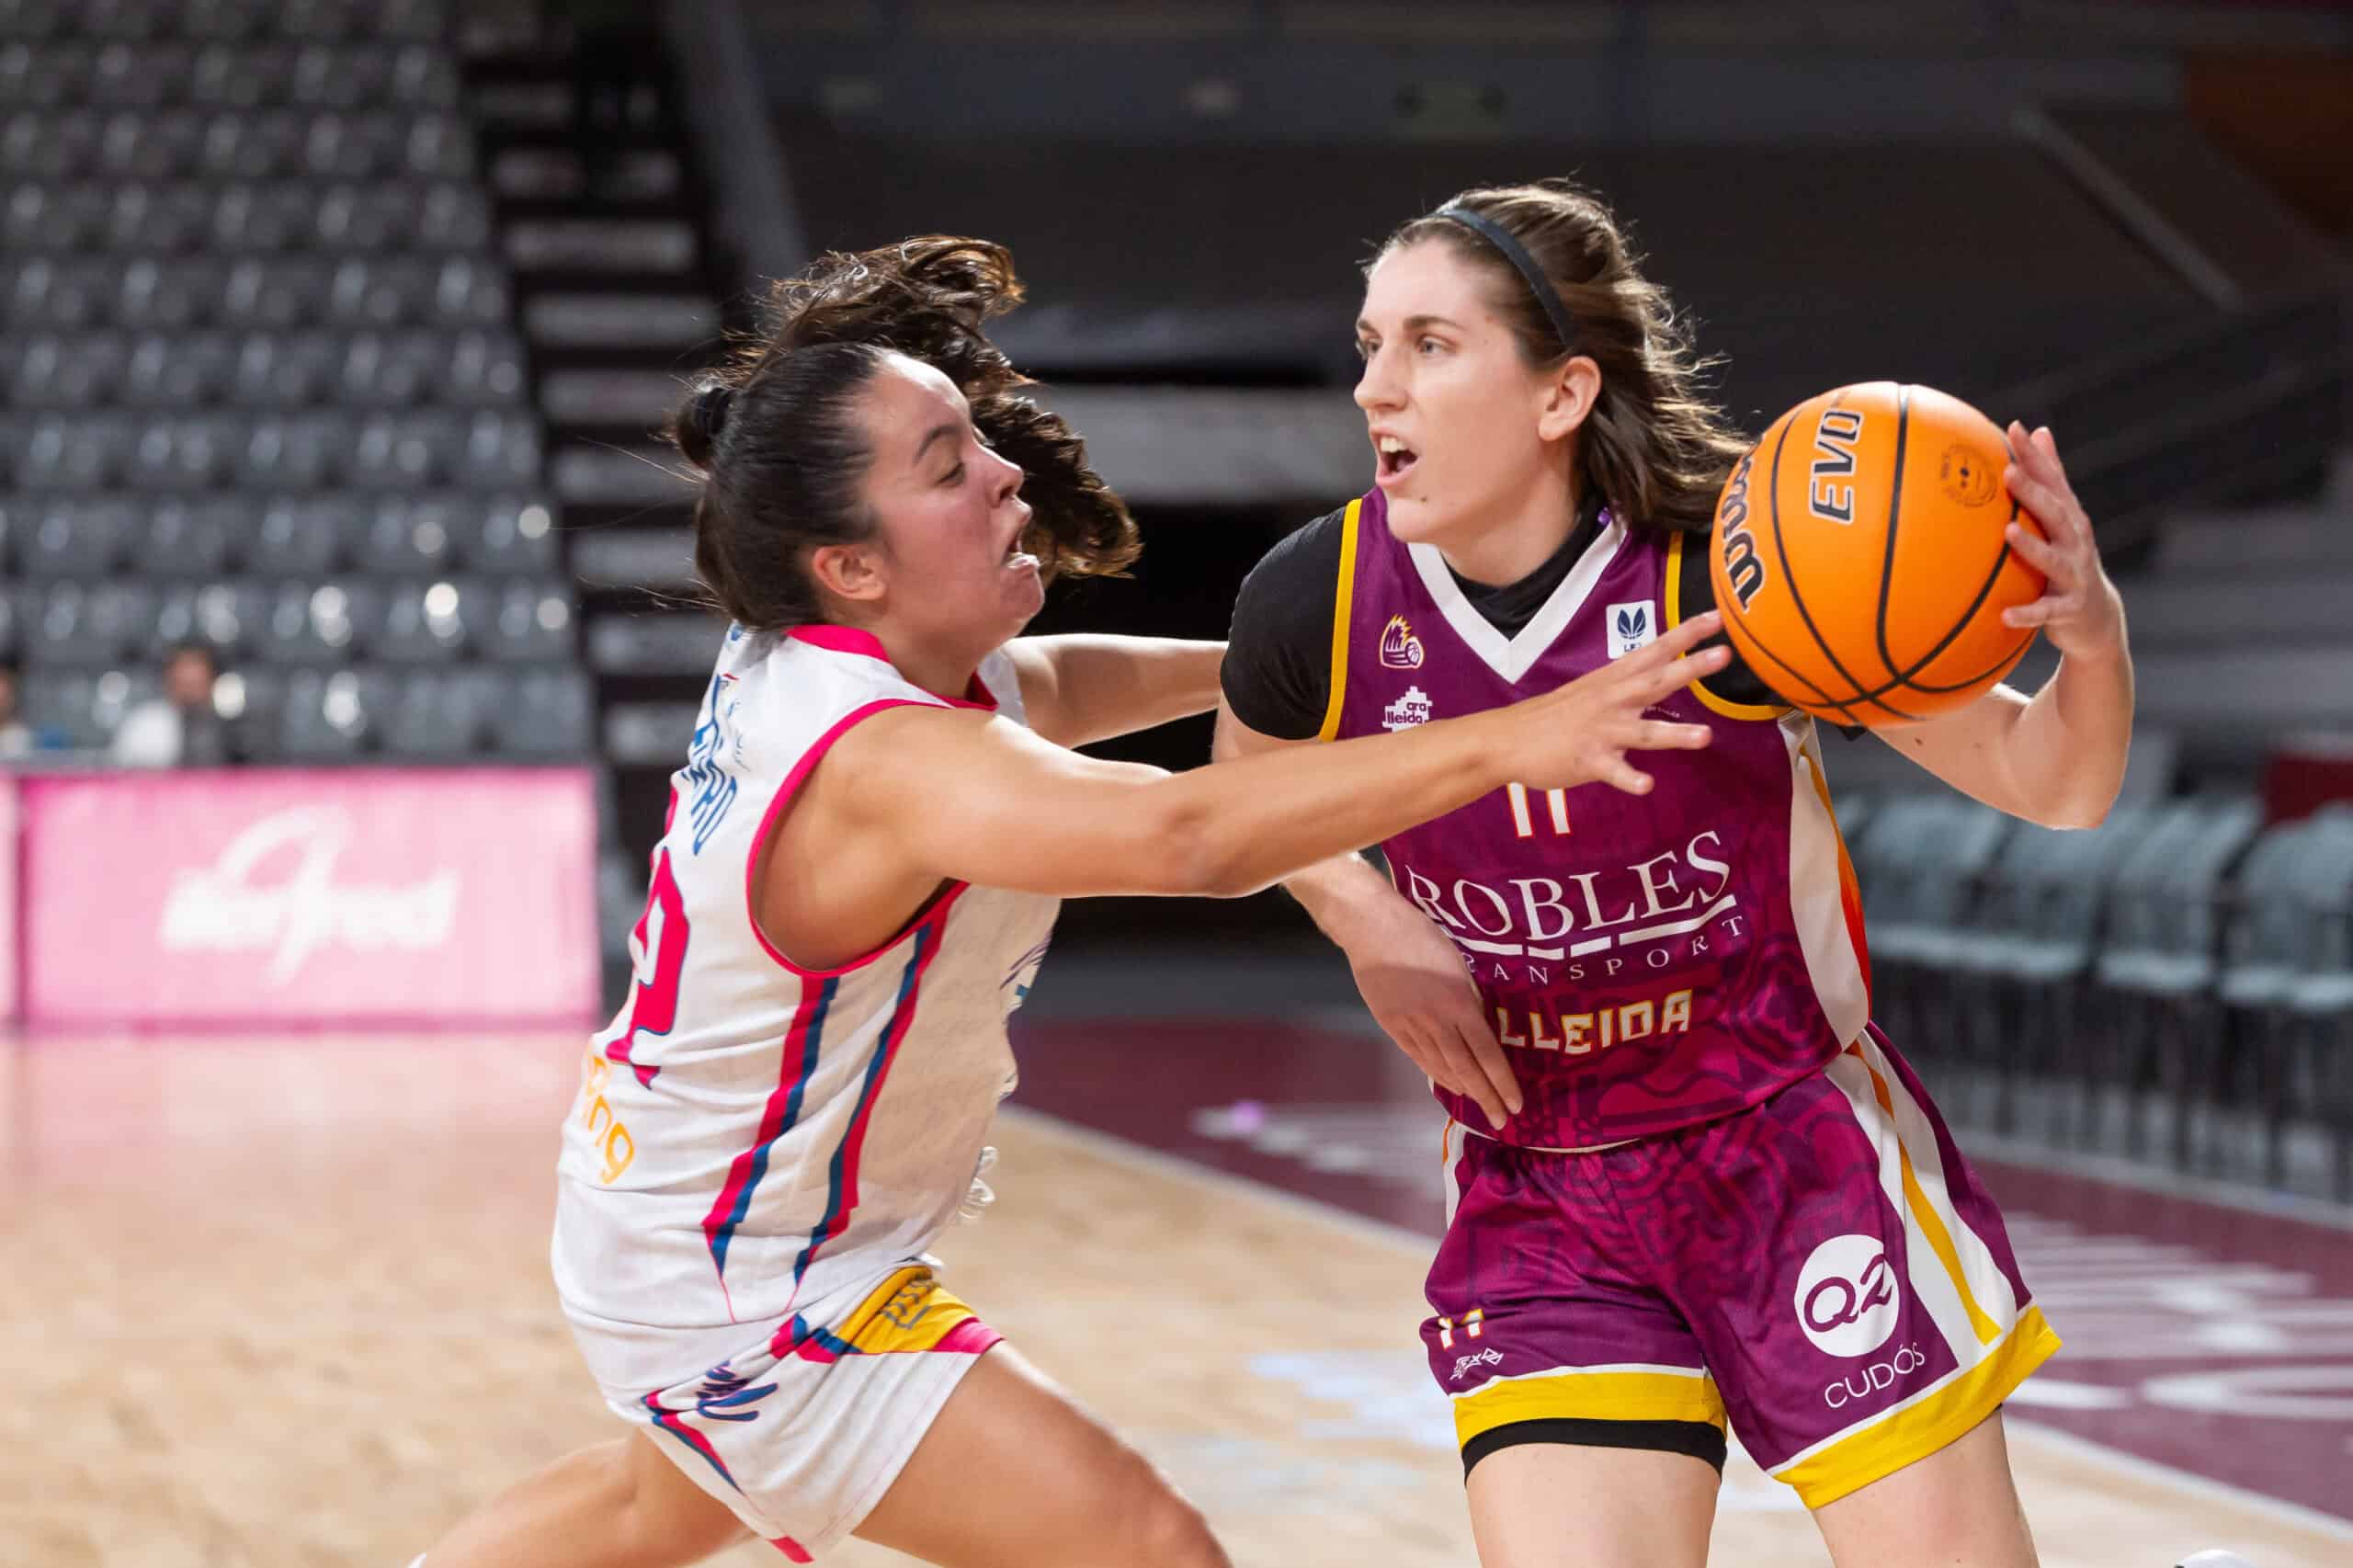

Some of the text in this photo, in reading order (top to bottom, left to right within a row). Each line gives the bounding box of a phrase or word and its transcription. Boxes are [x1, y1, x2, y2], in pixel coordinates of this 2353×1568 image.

[1810, 409, 1863, 524] EVO
[1387, 711, 1423, 724] lleida
[1406, 702, 1427, 711] ara
[1404, 830, 1730, 941] ROBLES
[1461, 915, 1744, 986] RANSPORT
[1495, 989, 1693, 1055] LLEIDA
[1803, 1253, 1893, 1334] Q2
[1824, 1342, 1926, 1408] CUDÓS
